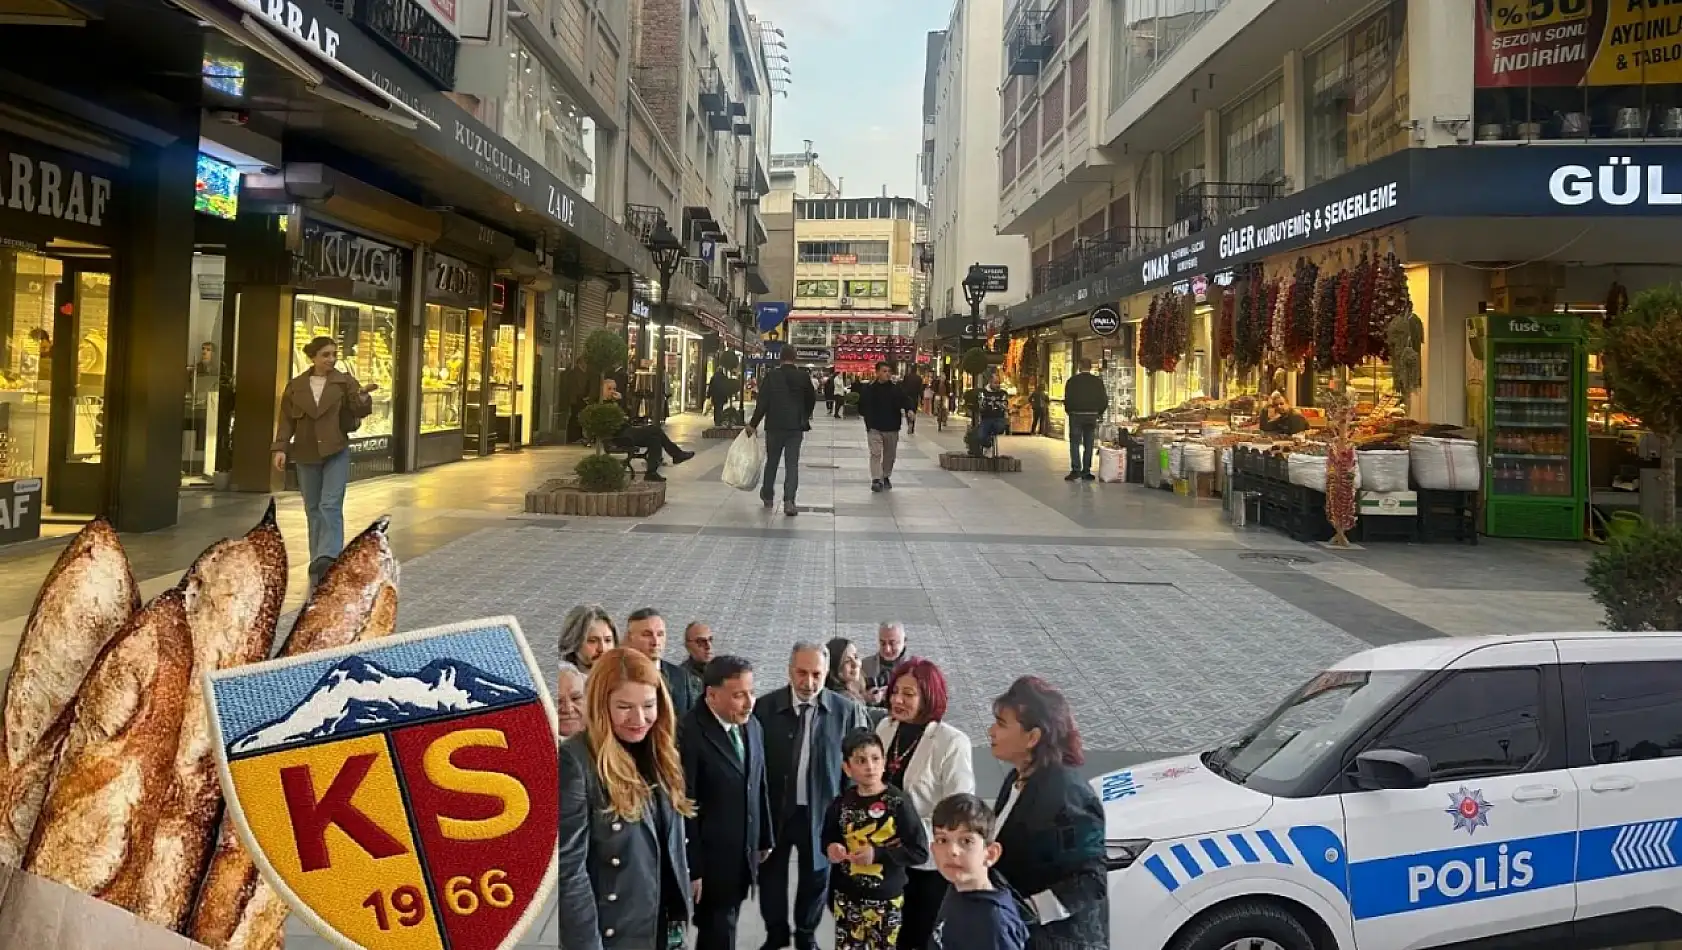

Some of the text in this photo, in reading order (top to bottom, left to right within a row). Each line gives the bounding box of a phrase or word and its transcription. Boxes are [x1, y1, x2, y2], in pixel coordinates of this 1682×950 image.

[1491, 24, 1586, 50] SEZON SONU
[1616, 44, 1681, 71] & TABLO
[454, 120, 530, 187] KUZUCULAR
[0, 152, 111, 226] RRAF
[1548, 156, 1682, 206] GÜL
[548, 185, 575, 228] ZADE
[1220, 181, 1397, 260] GÜLER KURUYEMİŞ & ŞEKERLEME
[1142, 253, 1170, 286] ÇINAR
[1407, 843, 1534, 903] POLİS
